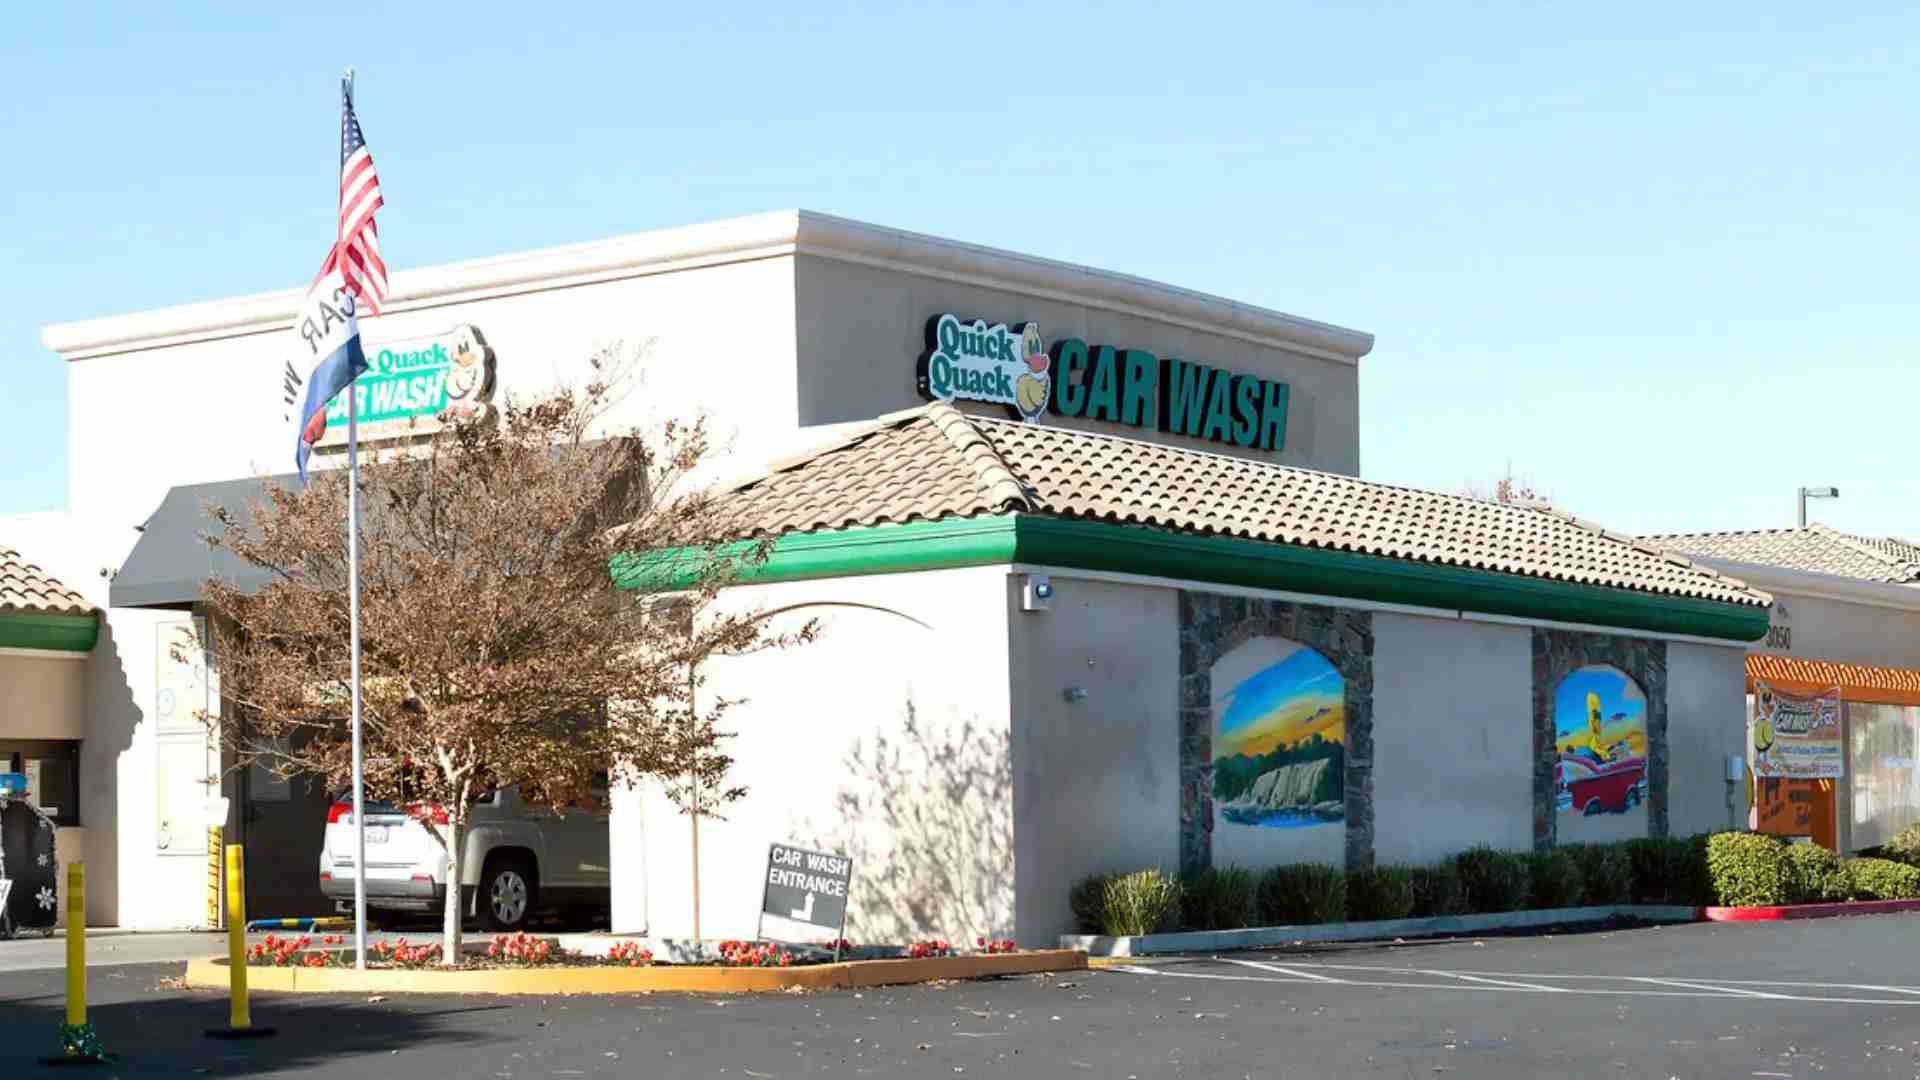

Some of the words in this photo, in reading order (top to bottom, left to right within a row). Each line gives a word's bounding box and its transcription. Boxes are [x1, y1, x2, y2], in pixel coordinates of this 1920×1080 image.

[378, 343, 448, 375] Quack
[940, 319, 1017, 362] Quick
[371, 371, 444, 415] WASH
[932, 355, 1014, 398] Quack
[1056, 337, 1158, 429] CAR
[1168, 358, 1290, 451] WASH
[769, 867, 847, 897] ENTRANCE
[772, 847, 802, 867] CAR
[807, 853, 849, 876] WASH
